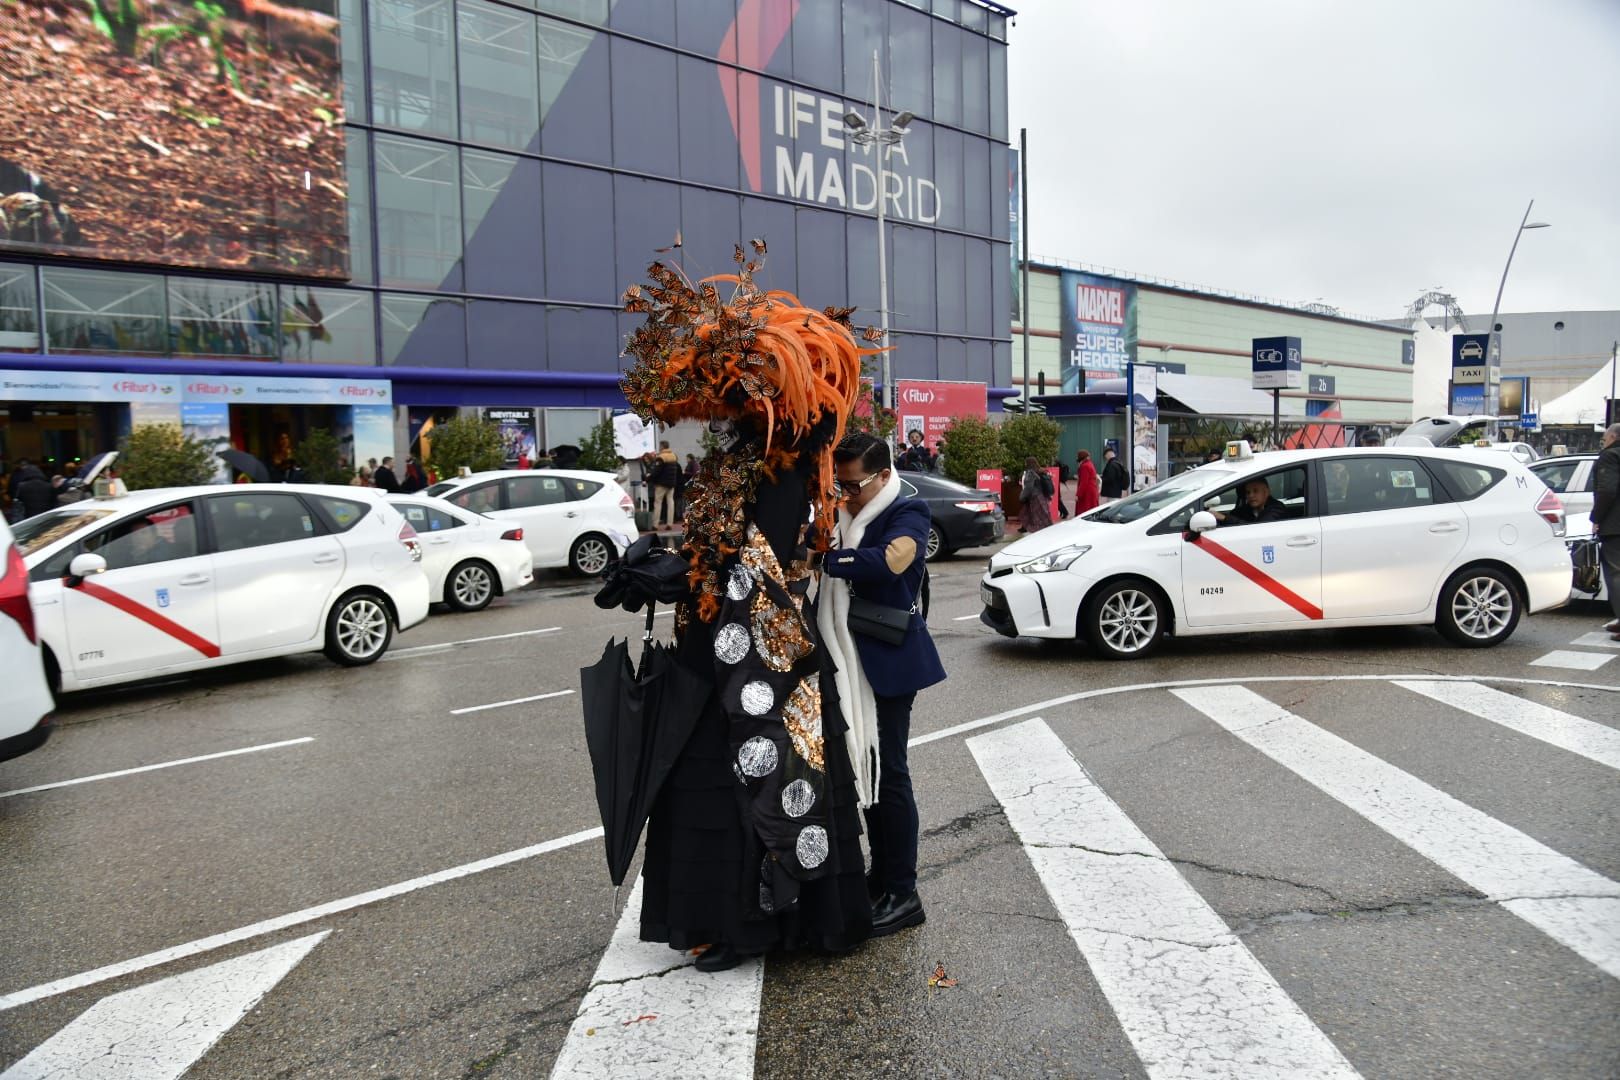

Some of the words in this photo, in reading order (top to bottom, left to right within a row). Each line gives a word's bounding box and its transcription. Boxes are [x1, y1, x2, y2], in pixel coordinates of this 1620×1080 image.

[775, 146, 941, 224] MADRID
[1078, 286, 1123, 324] MARVEL
[1076, 333, 1125, 353] SUPER
[1070, 349, 1130, 370] HEROES
[1460, 369, 1481, 377] TAXI
[1318, 378, 1327, 392] 2b
[1515, 475, 1528, 489] M
[1200, 586, 1224, 596] 04249
